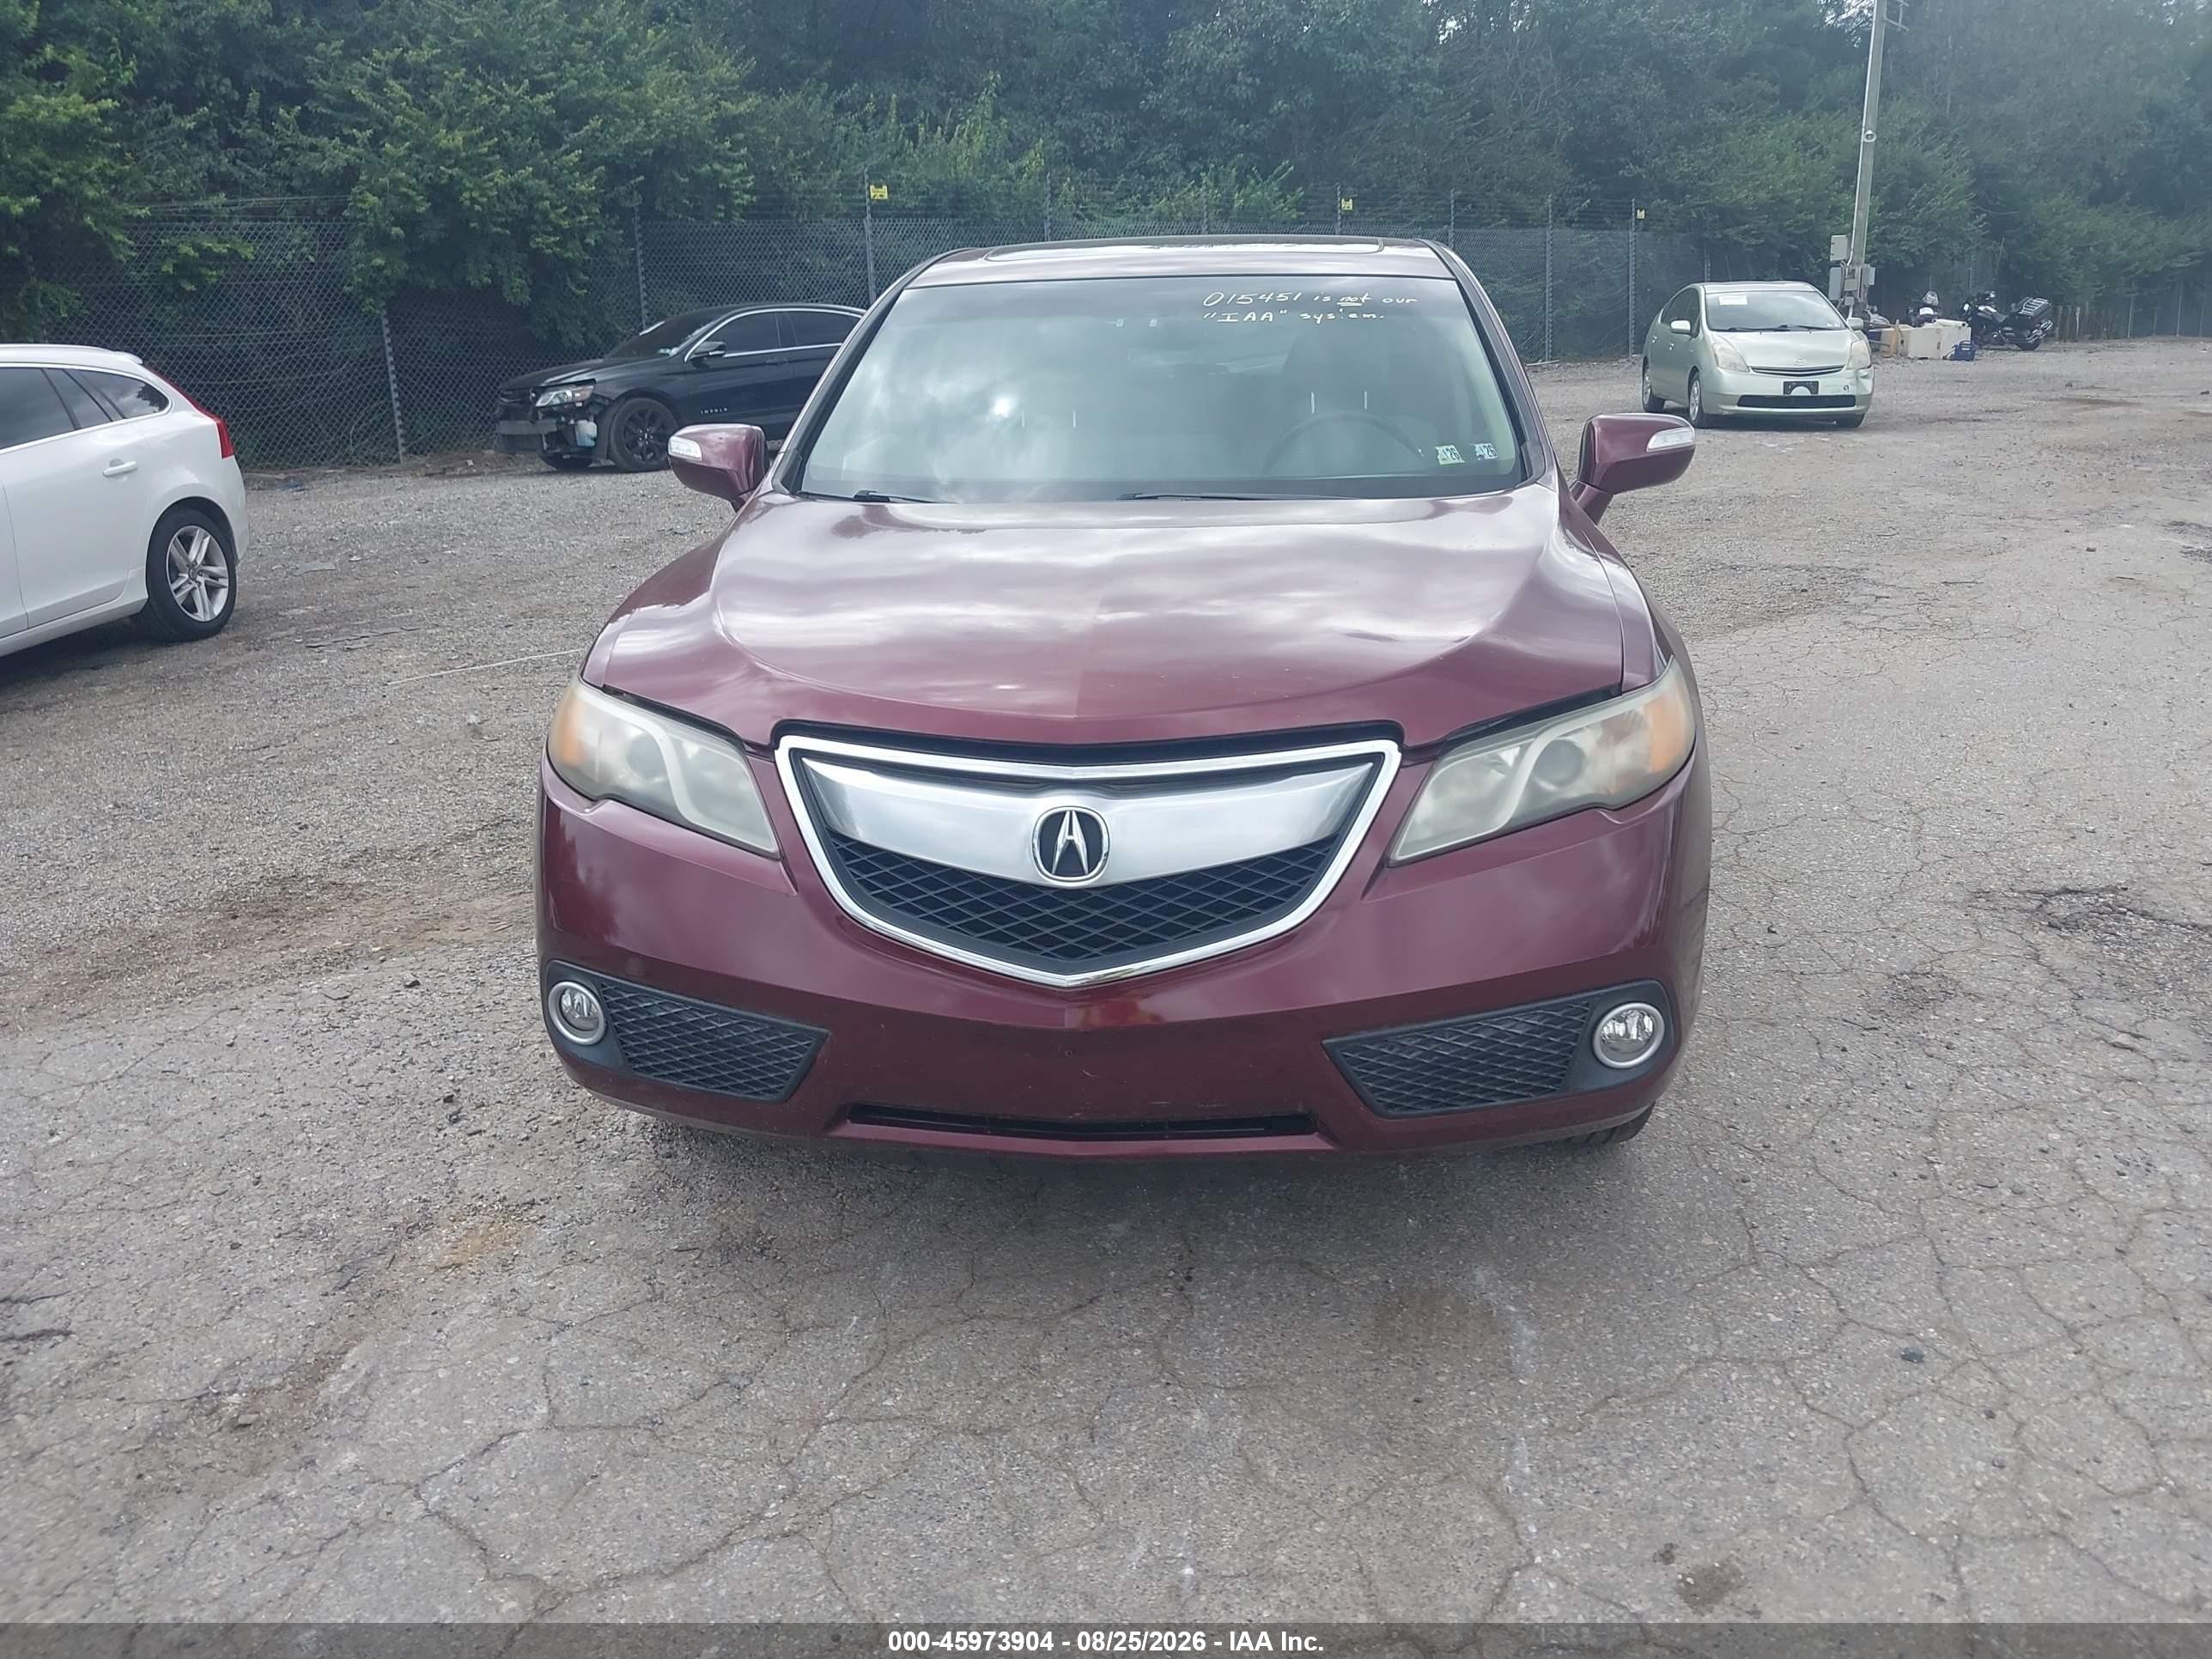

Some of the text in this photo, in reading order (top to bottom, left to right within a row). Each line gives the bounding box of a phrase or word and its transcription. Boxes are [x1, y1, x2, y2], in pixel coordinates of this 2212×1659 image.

[1202, 291, 1302, 307] 015451
[1313, 291, 1331, 301] is
[1336, 292, 1372, 307] not
